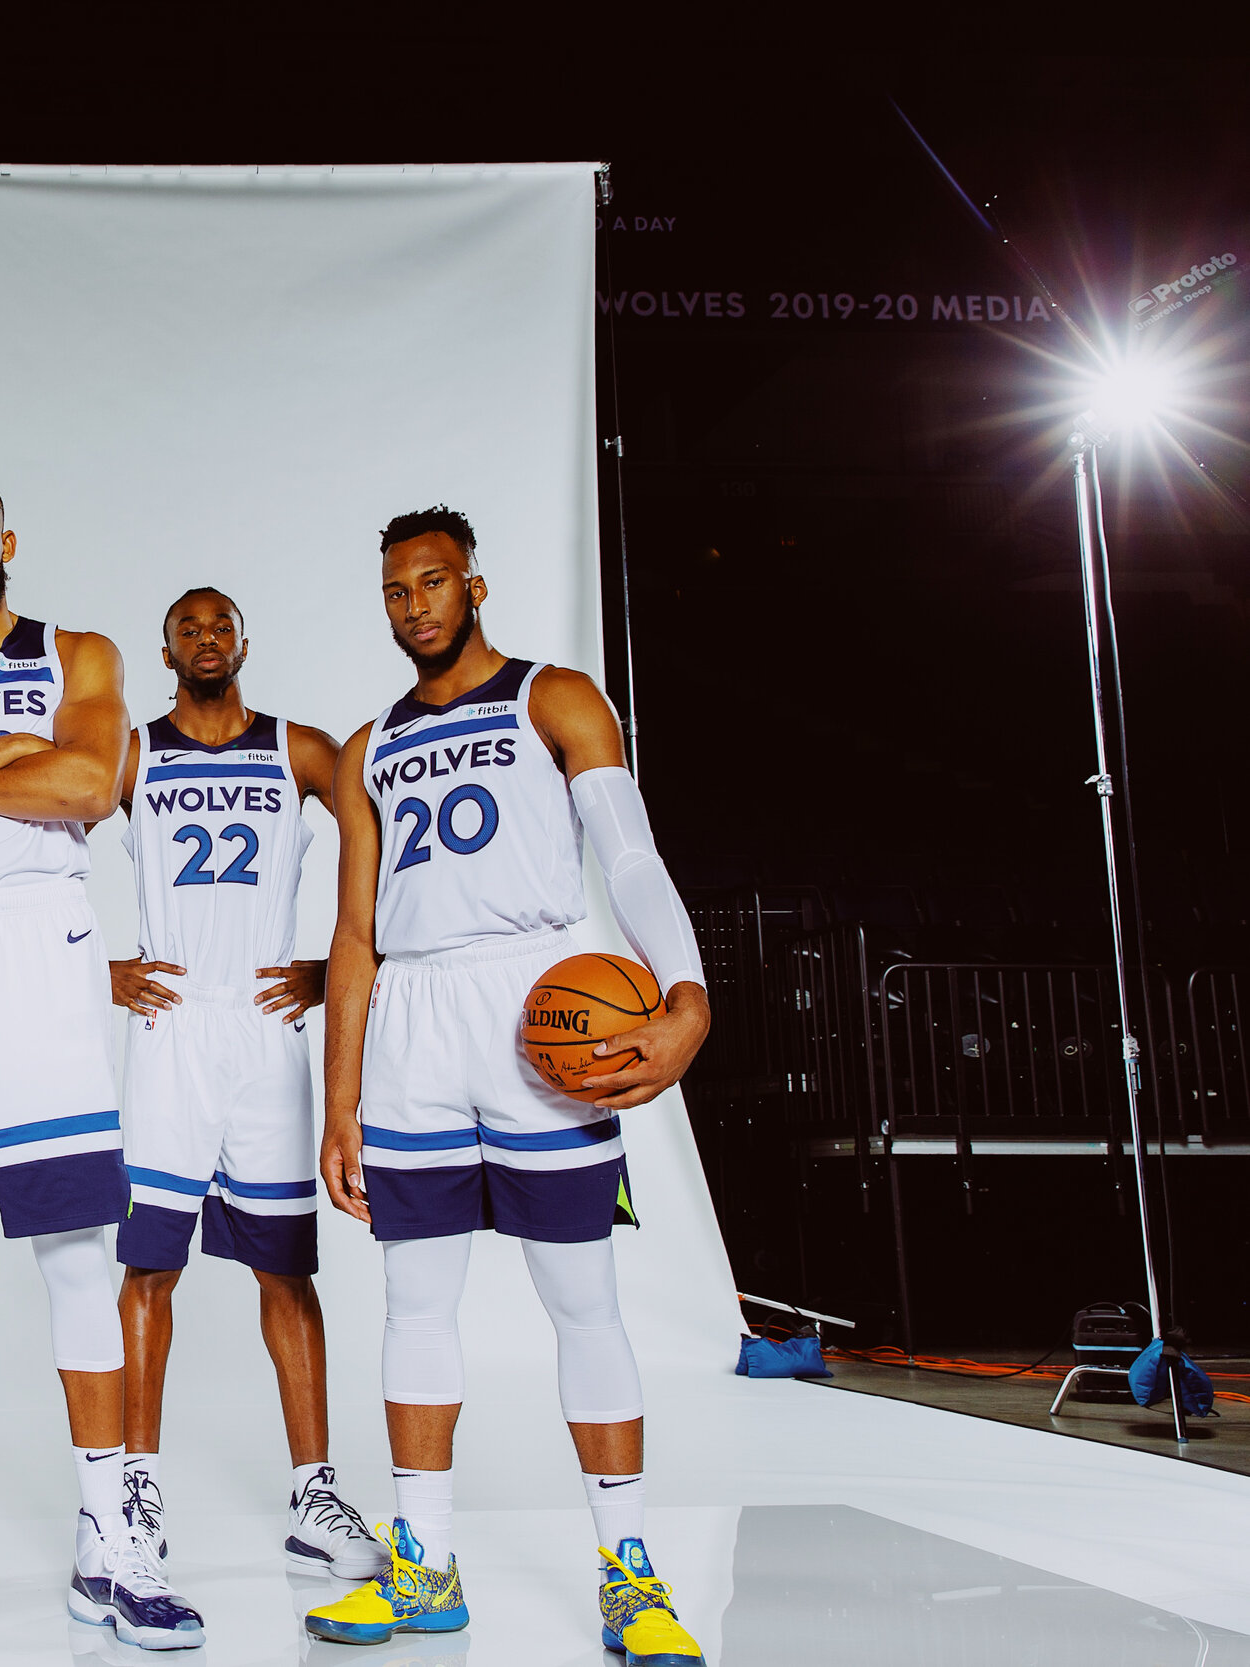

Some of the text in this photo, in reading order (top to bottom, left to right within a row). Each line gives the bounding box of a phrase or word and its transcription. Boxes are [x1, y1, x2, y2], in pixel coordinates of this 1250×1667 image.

[634, 215, 677, 232] DAY
[1151, 252, 1237, 303] Profoto
[596, 290, 1051, 322] WOLVES 2019-20 MEDIA
[1134, 284, 1212, 332] Umbrella Deep
[8, 660, 38, 669] fitbit
[477, 704, 509, 716] fitbit
[248, 752, 274, 762] fitbit
[371, 738, 517, 798] WOLVES
[145, 786, 282, 817] WOLVES
[393, 783, 500, 875] 20
[172, 822, 260, 887] 22
[525, 1009, 590, 1036] ALDING
